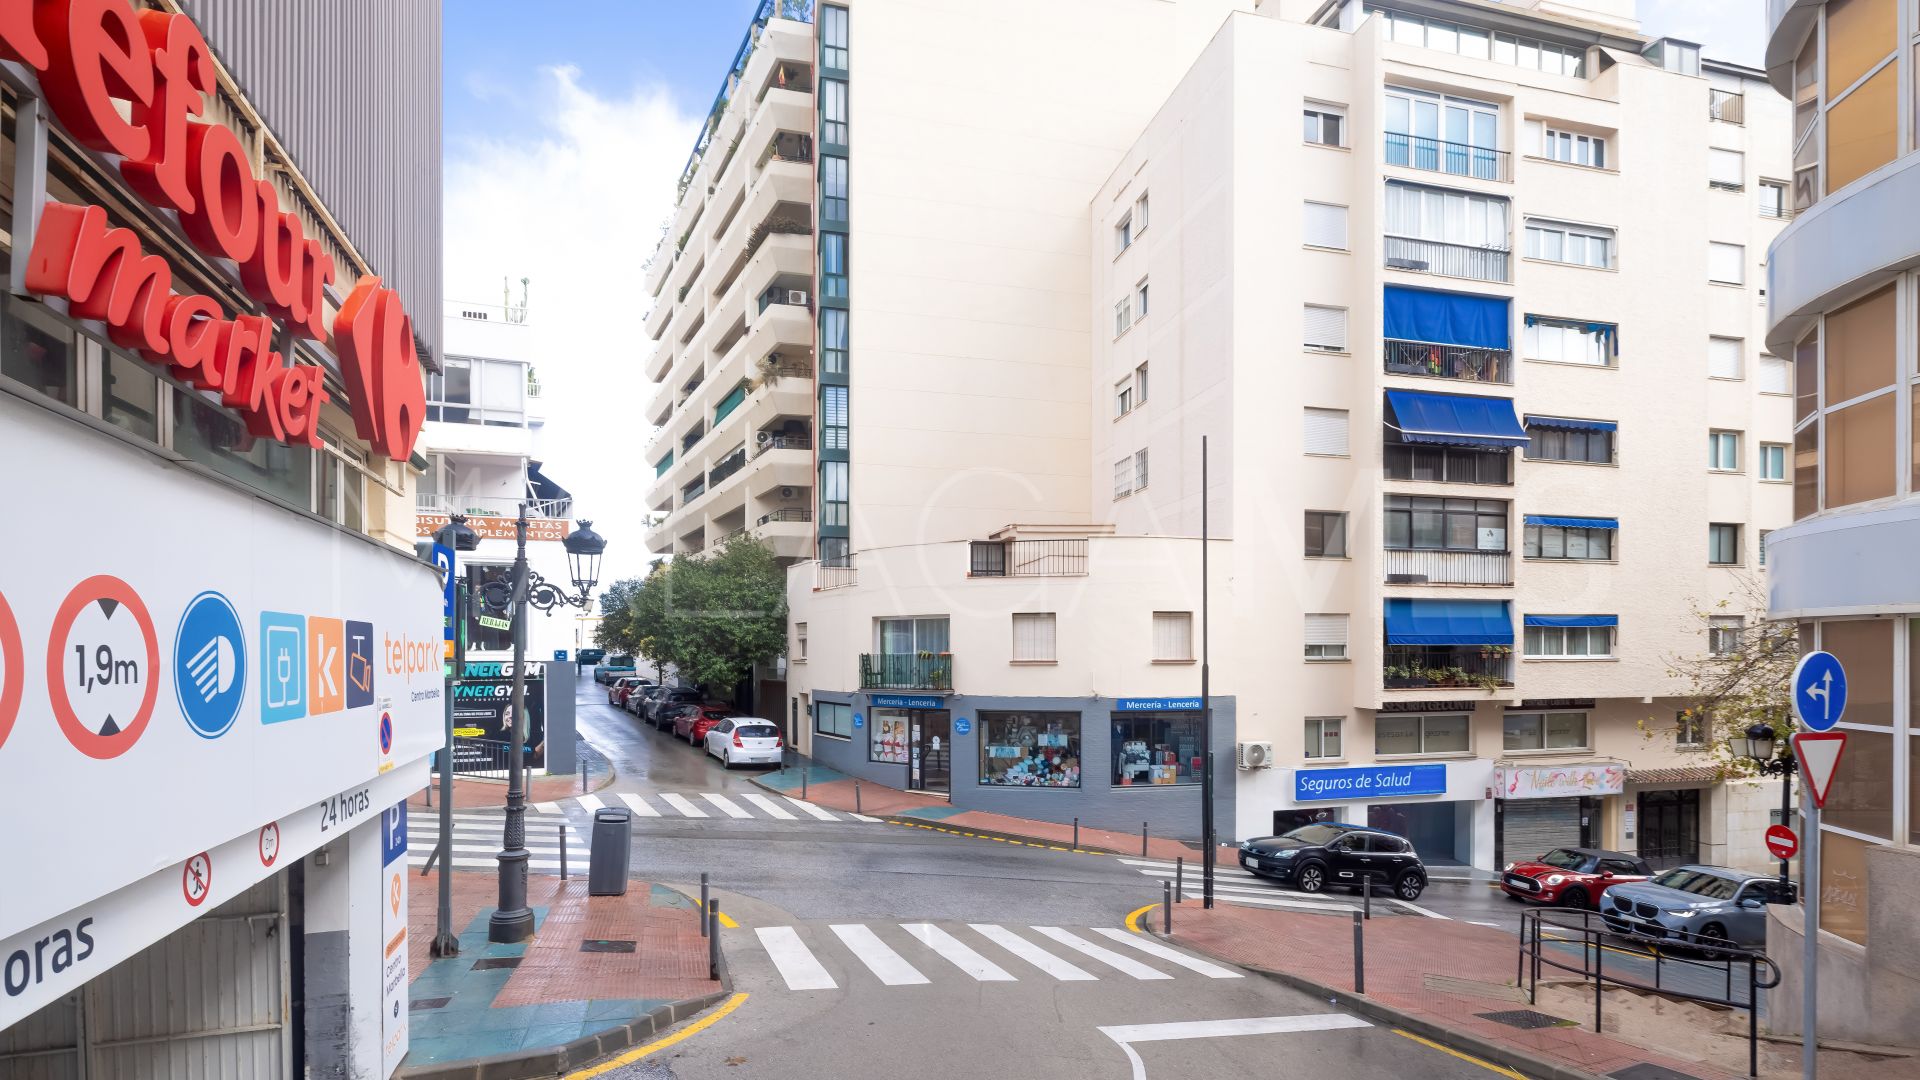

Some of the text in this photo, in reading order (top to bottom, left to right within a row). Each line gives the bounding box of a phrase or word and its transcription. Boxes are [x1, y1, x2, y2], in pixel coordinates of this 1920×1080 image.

[58, 203, 331, 449] market
[415, 515, 562, 529] BISUTRIA METAS
[480, 616, 510, 629] REBAJAS
[75, 644, 138, 694] 1,9m
[384, 631, 439, 685] telpark
[1126, 700, 1161, 709] Mercería
[1168, 700, 1200, 709] Lencería
[1300, 771, 1412, 795] Seguros de Salud
[320, 788, 370, 832] 24 horas
[389, 803, 400, 850] P
[4, 916, 94, 997] oras
